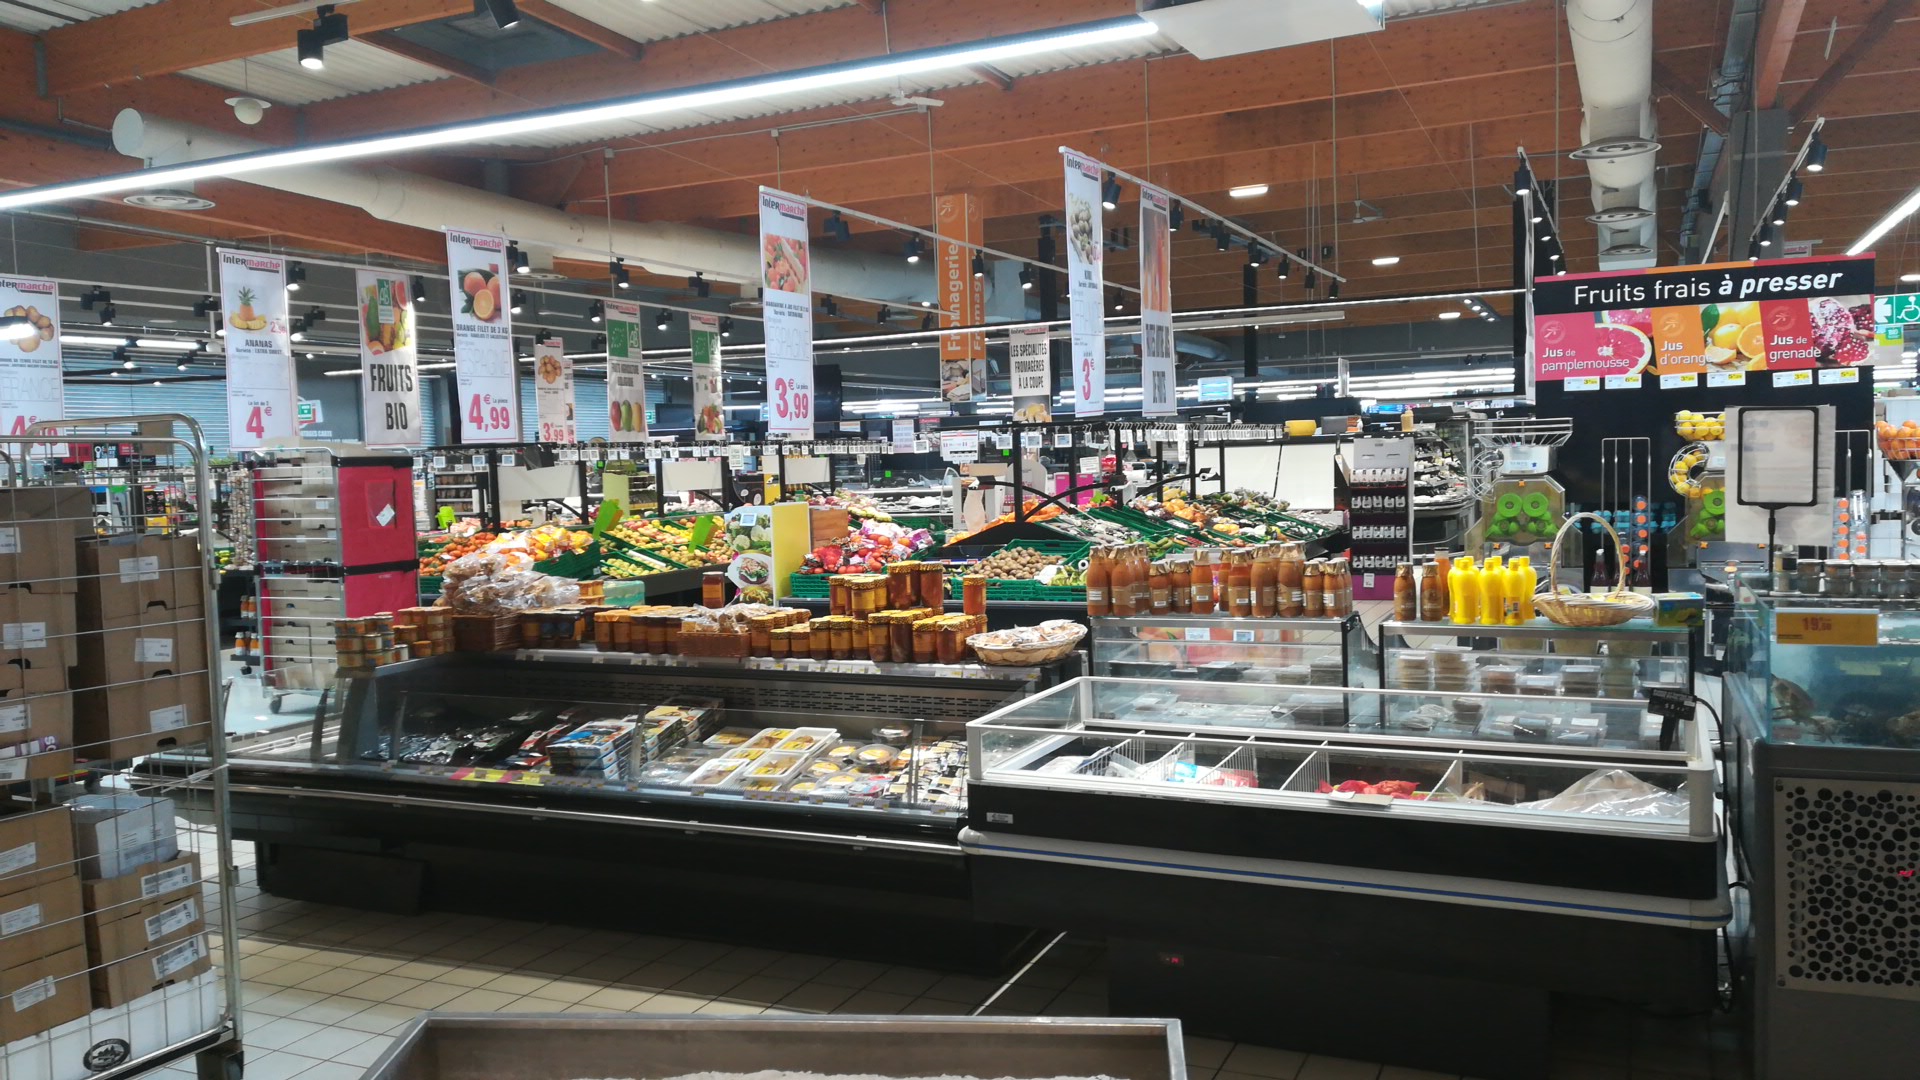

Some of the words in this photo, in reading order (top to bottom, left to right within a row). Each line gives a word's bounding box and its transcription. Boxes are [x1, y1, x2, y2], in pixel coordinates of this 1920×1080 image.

[1575, 283, 1645, 305] Fruits
[1654, 278, 1711, 300] frais
[1718, 273, 1733, 296] à
[1739, 272, 1843, 299] presser
[456, 323, 476, 332] ORANGE
[477, 325, 489, 333] FILET
[245, 339, 273, 348] ANANAS
[1661, 340, 1683, 352] Jus
[1770, 334, 1794, 346] Jus
[1796, 336, 1807, 345] de
[1010, 344, 1019, 357] LES
[1020, 340, 1047, 357] SPÉCIALITÉS
[1542, 347, 1563, 358] Jus
[1565, 349, 1576, 357] de
[1769, 347, 1821, 363] grenade
[1014, 357, 1045, 373] FROMAGÈRES
[1541, 358, 1630, 374] pamplemousse
[370, 363, 413, 392] FRUITS
[1022, 376, 1029, 389] LA
[1029, 375, 1044, 388] COUPE
[385, 402, 408, 430] BIO
